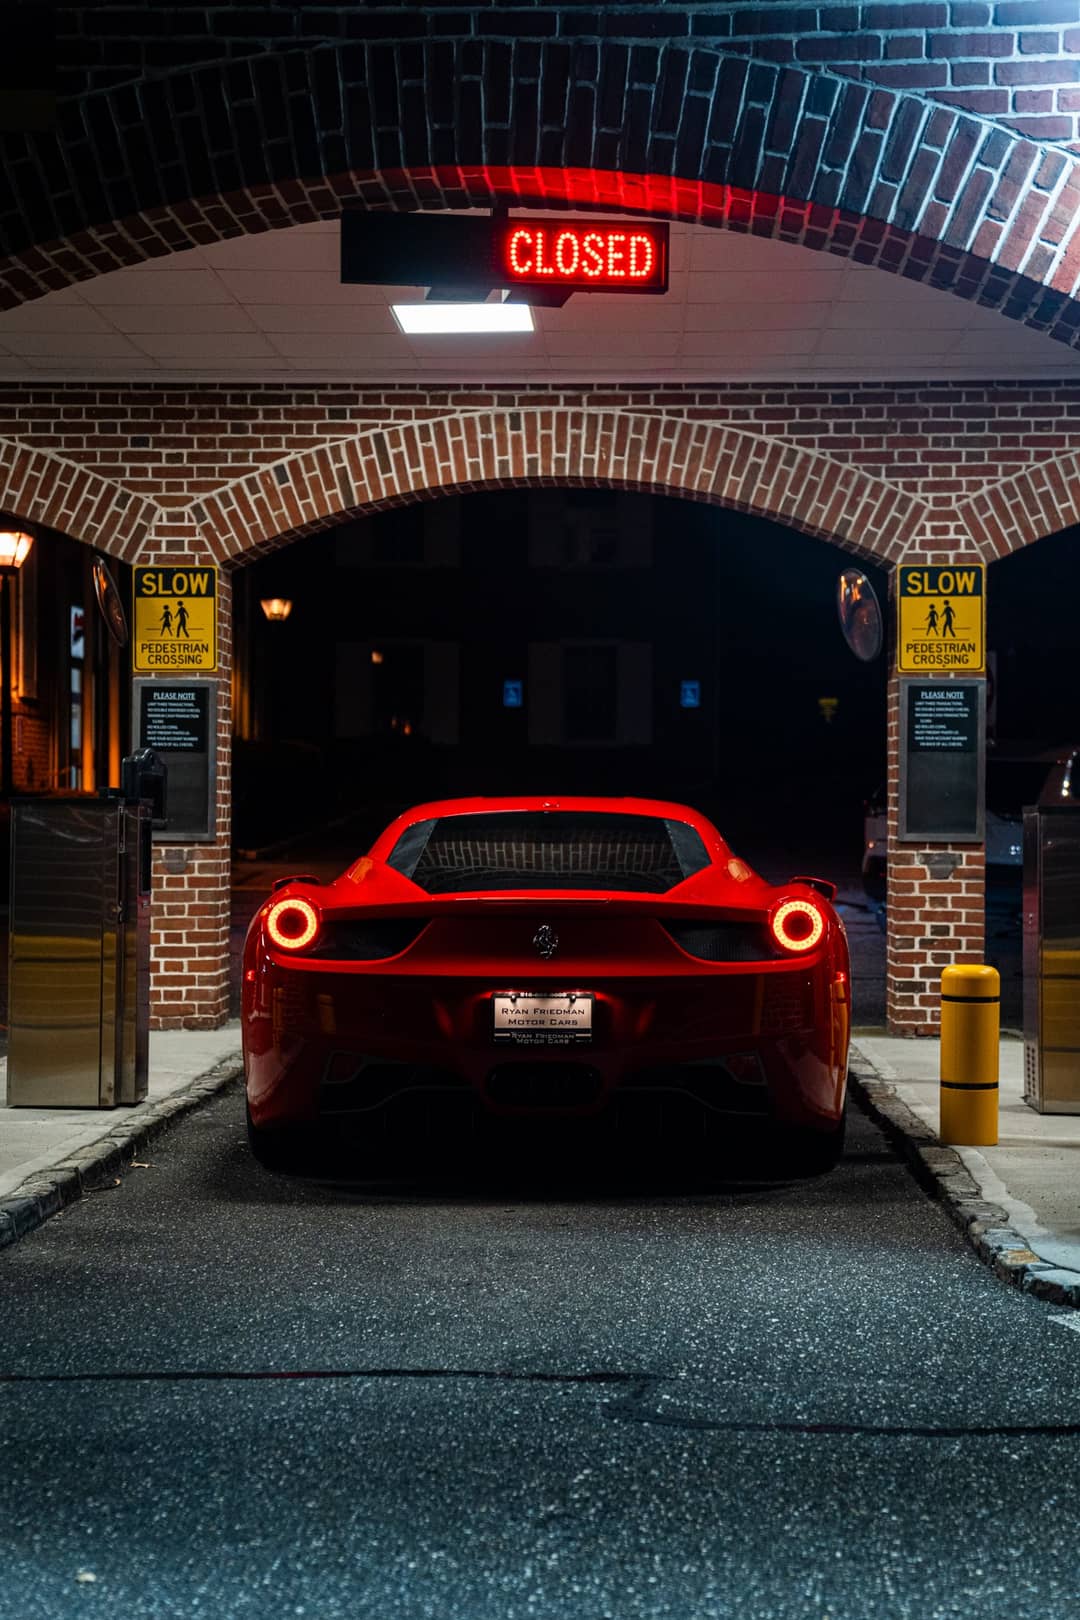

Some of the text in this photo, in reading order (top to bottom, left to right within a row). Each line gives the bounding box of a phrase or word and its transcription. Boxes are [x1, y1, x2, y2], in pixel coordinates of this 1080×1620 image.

[510, 230, 652, 277] CLOSED
[142, 573, 209, 595] SLOW
[907, 572, 976, 594] SLOW
[141, 643, 209, 654] PEDESTRIAN
[906, 643, 976, 654] PEDESTRIAN
[148, 654, 203, 665] CROSSING
[912, 654, 969, 665] CROSSING
[153, 692, 196, 700] PLEASE NOTE
[920, 691, 964, 700] PLEASE NOTE
